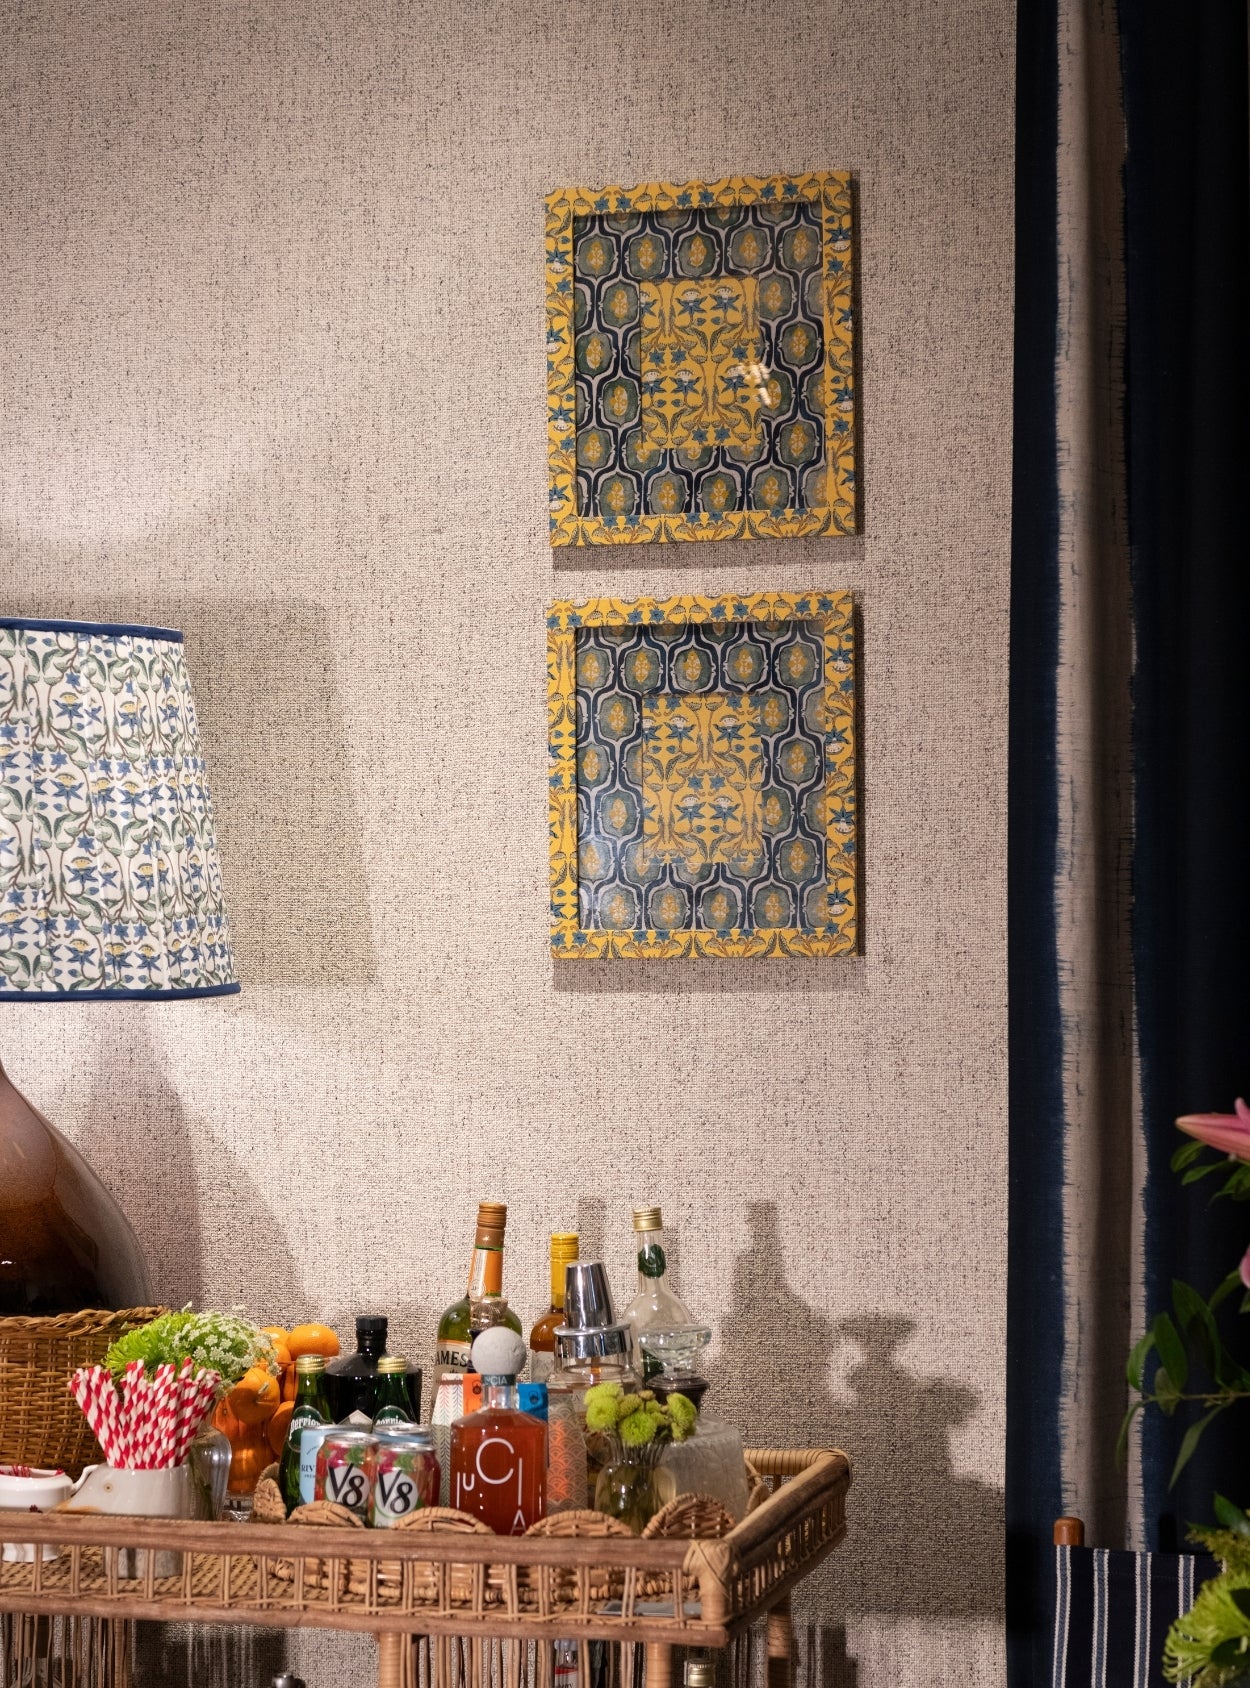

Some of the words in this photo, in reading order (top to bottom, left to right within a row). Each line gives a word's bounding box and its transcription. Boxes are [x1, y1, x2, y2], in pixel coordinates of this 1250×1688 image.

[435, 1350, 468, 1368] AMES
[328, 1462, 365, 1508] V8
[378, 1469, 413, 1514] V8
